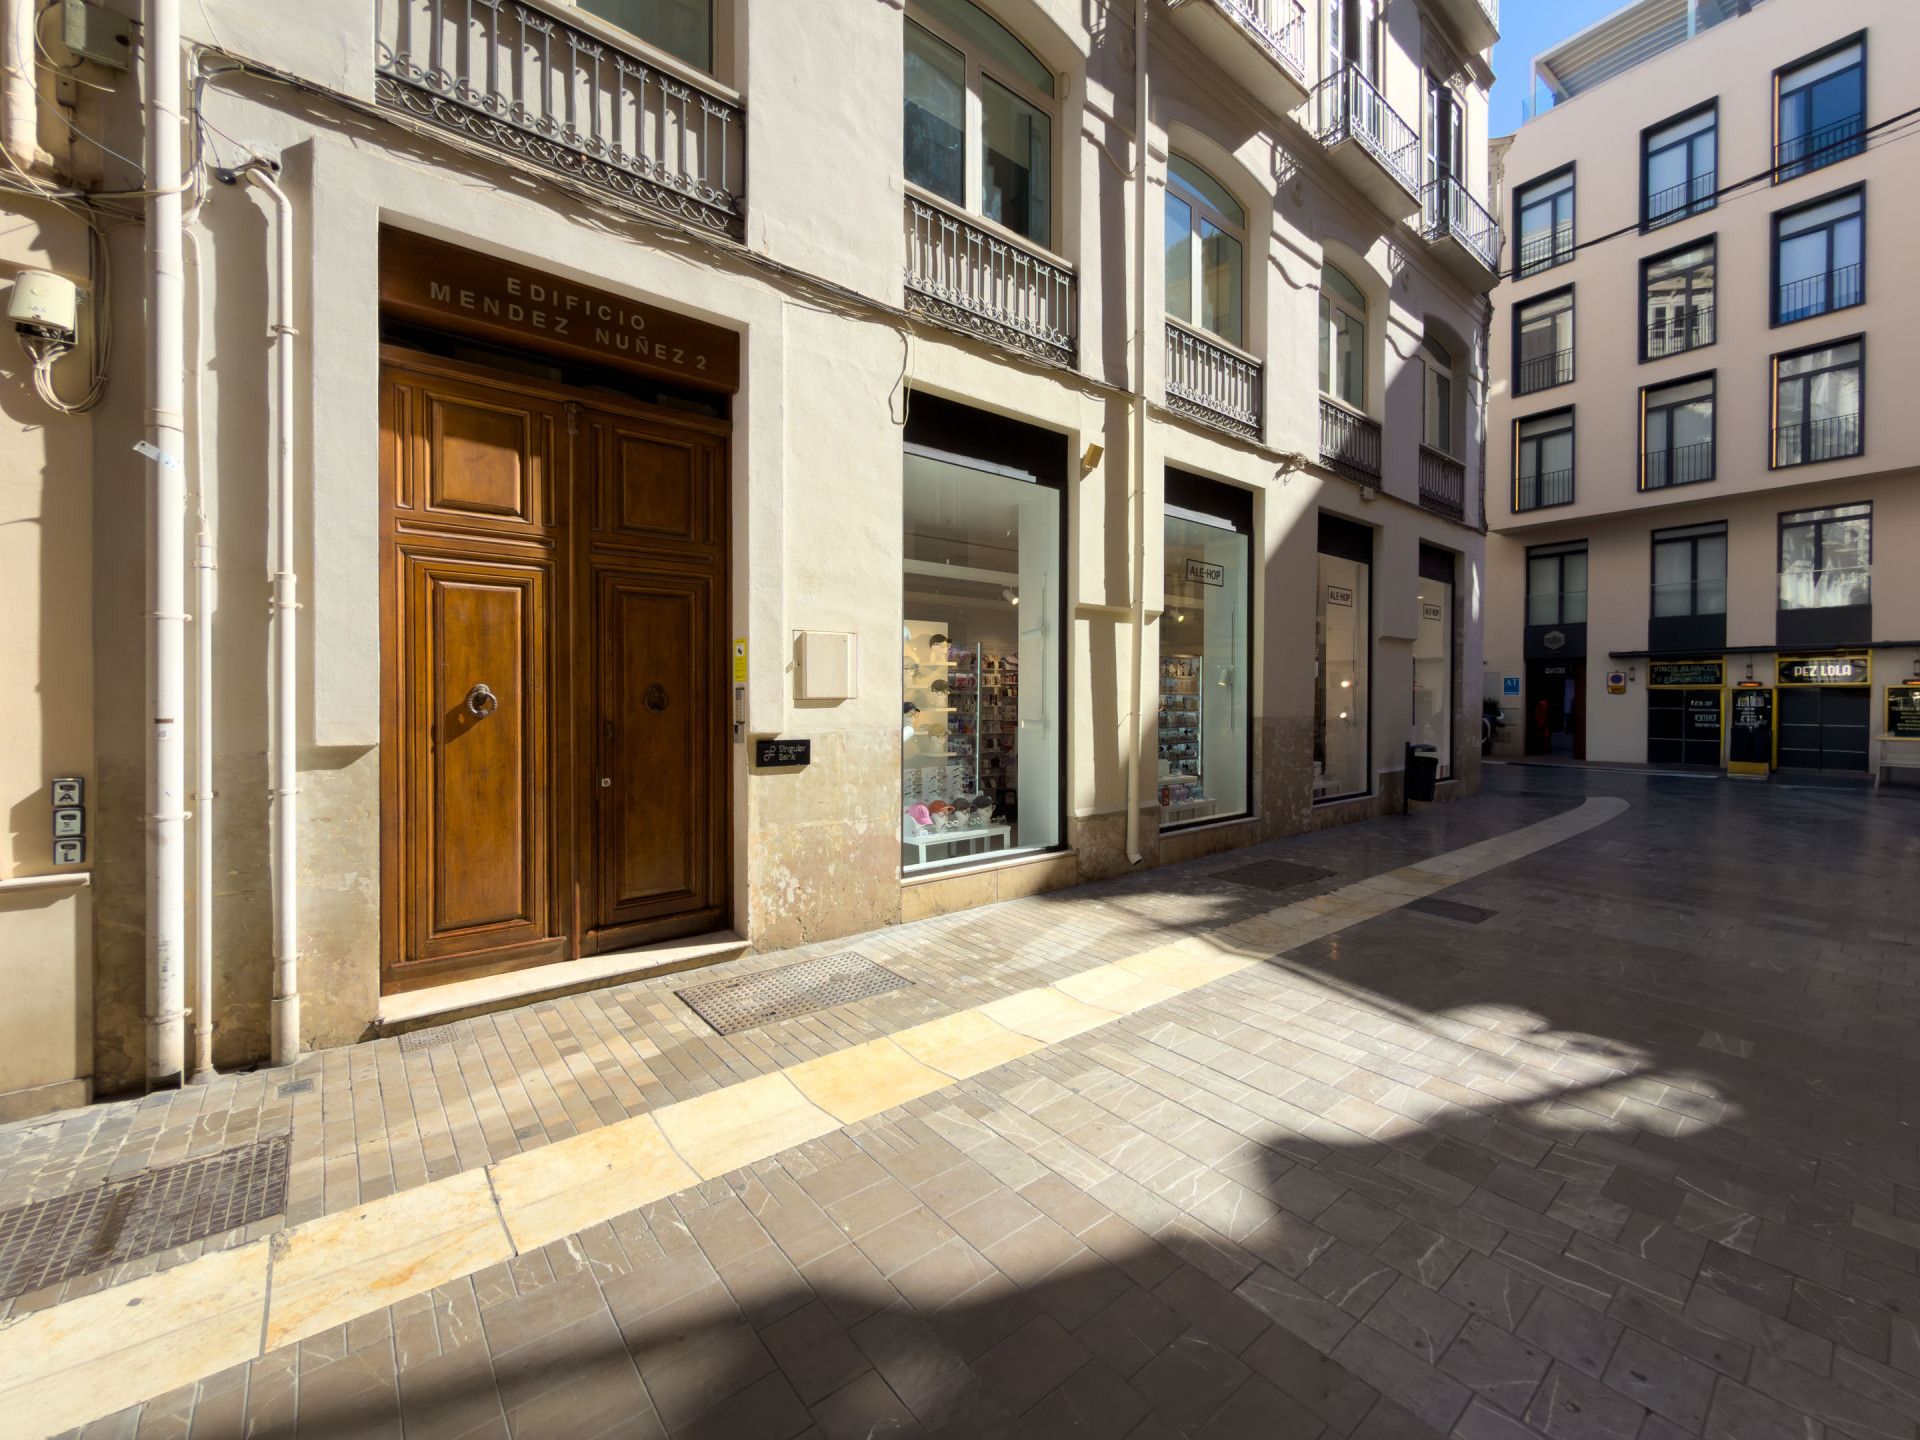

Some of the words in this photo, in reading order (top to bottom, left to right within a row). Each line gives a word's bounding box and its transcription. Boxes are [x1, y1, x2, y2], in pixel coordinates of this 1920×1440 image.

[507, 277, 645, 330] EDIFICIO
[430, 281, 569, 335] MENDEZ
[595, 327, 684, 364] NUÑEZ
[696, 355, 707, 370] 2
[1190, 565, 1221, 580] ALE-HOP
[1329, 591, 1351, 601] ALE-HOP
[1793, 665, 1818, 677] PEZ
[1820, 664, 1852, 677] LOLA
[778, 744, 806, 755] Singular
[778, 753, 797, 761] Bank
